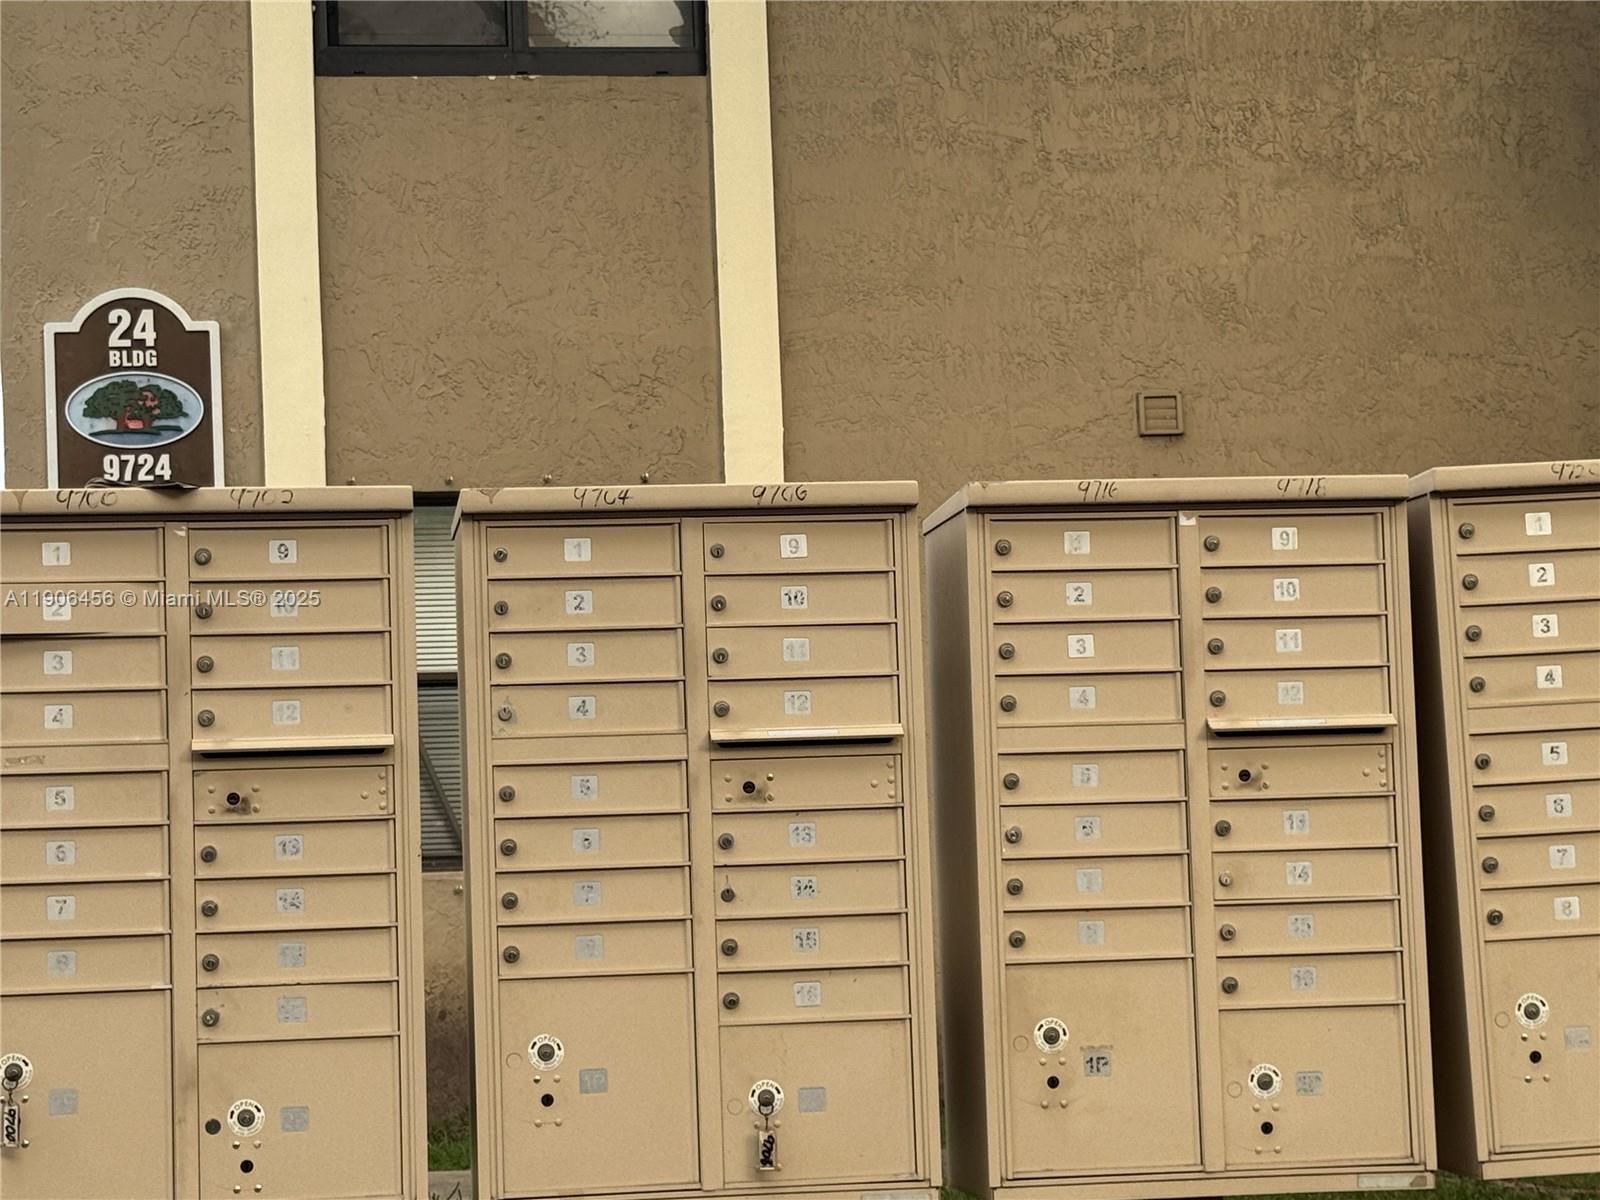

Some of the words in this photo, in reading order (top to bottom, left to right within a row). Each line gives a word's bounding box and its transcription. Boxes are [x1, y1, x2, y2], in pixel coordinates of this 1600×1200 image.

[108, 308, 157, 348] 24
[109, 350, 158, 367] BLDG
[103, 453, 172, 482] 9724
[1534, 515, 1543, 532] 1
[788, 538, 799, 554] 9
[1280, 531, 1289, 547] 9
[52, 546, 60, 563] 1
[277, 543, 289, 559] 9
[573, 542, 583, 557] 1
[1537, 567, 1547, 583] 2
[1073, 586, 1085, 602] 2
[1276, 581, 1296, 597] 10
[573, 594, 585, 611] 2
[784, 590, 804, 606] 10
[1540, 618, 1550, 633] 3
[1076, 638, 1086, 654] 3
[1279, 633, 1298, 649] 11
[53, 654, 64, 671] 3
[575, 647, 587, 663] 3
[1545, 670, 1555, 684] 4
[576, 699, 588, 717] 4
[790, 695, 808, 712] 12
[52, 708, 63, 725] 4
[1550, 746, 1560, 760] 5
[54, 790, 66, 806] 5
[1554, 798, 1564, 814] 6
[56, 844, 66, 861] 6
[279, 838, 300, 856] 13
[1557, 848, 1567, 865] 7
[55, 899, 67, 915] 7
[1561, 901, 1571, 917] 8
[5, 1108, 17, 1142] 9700
